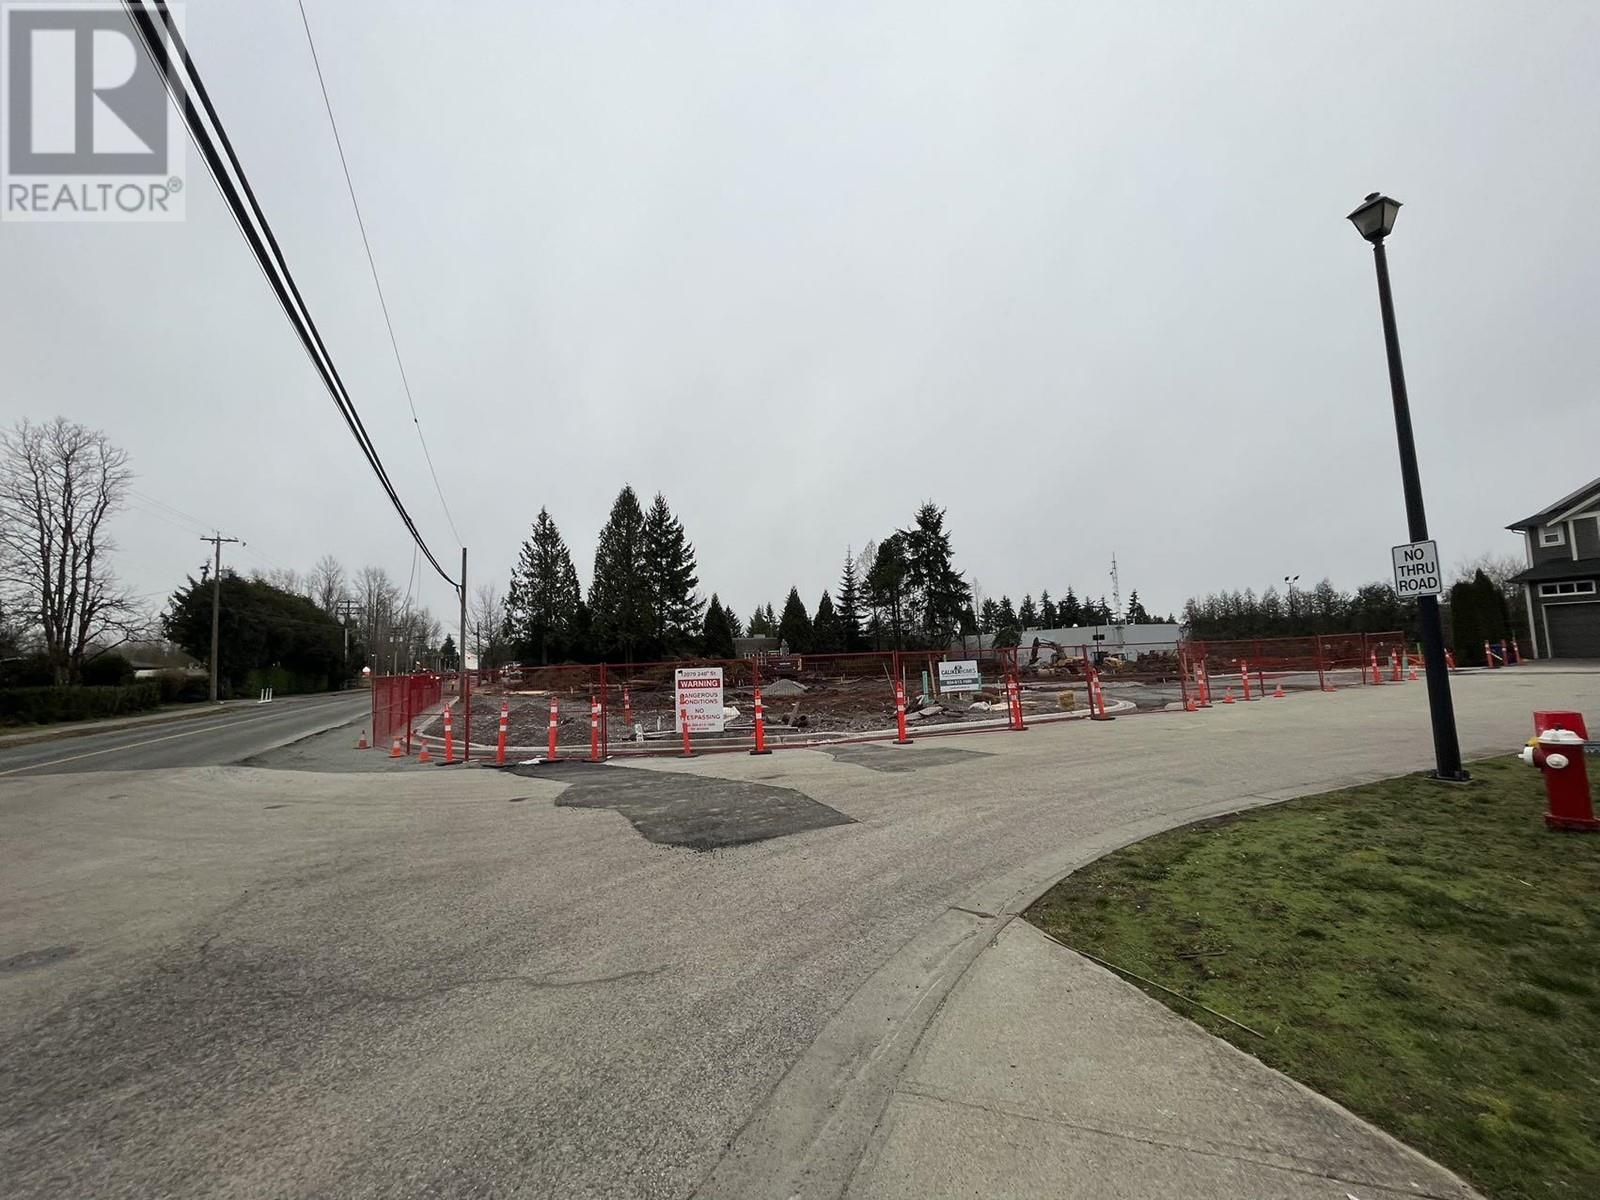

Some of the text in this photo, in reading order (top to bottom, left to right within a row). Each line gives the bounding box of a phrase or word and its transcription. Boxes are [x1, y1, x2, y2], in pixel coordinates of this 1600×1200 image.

[1404, 548, 1424, 562] NO
[1398, 561, 1435, 577] THRU
[1399, 577, 1437, 592] ROAD
[680, 680, 718, 688] WARNING
